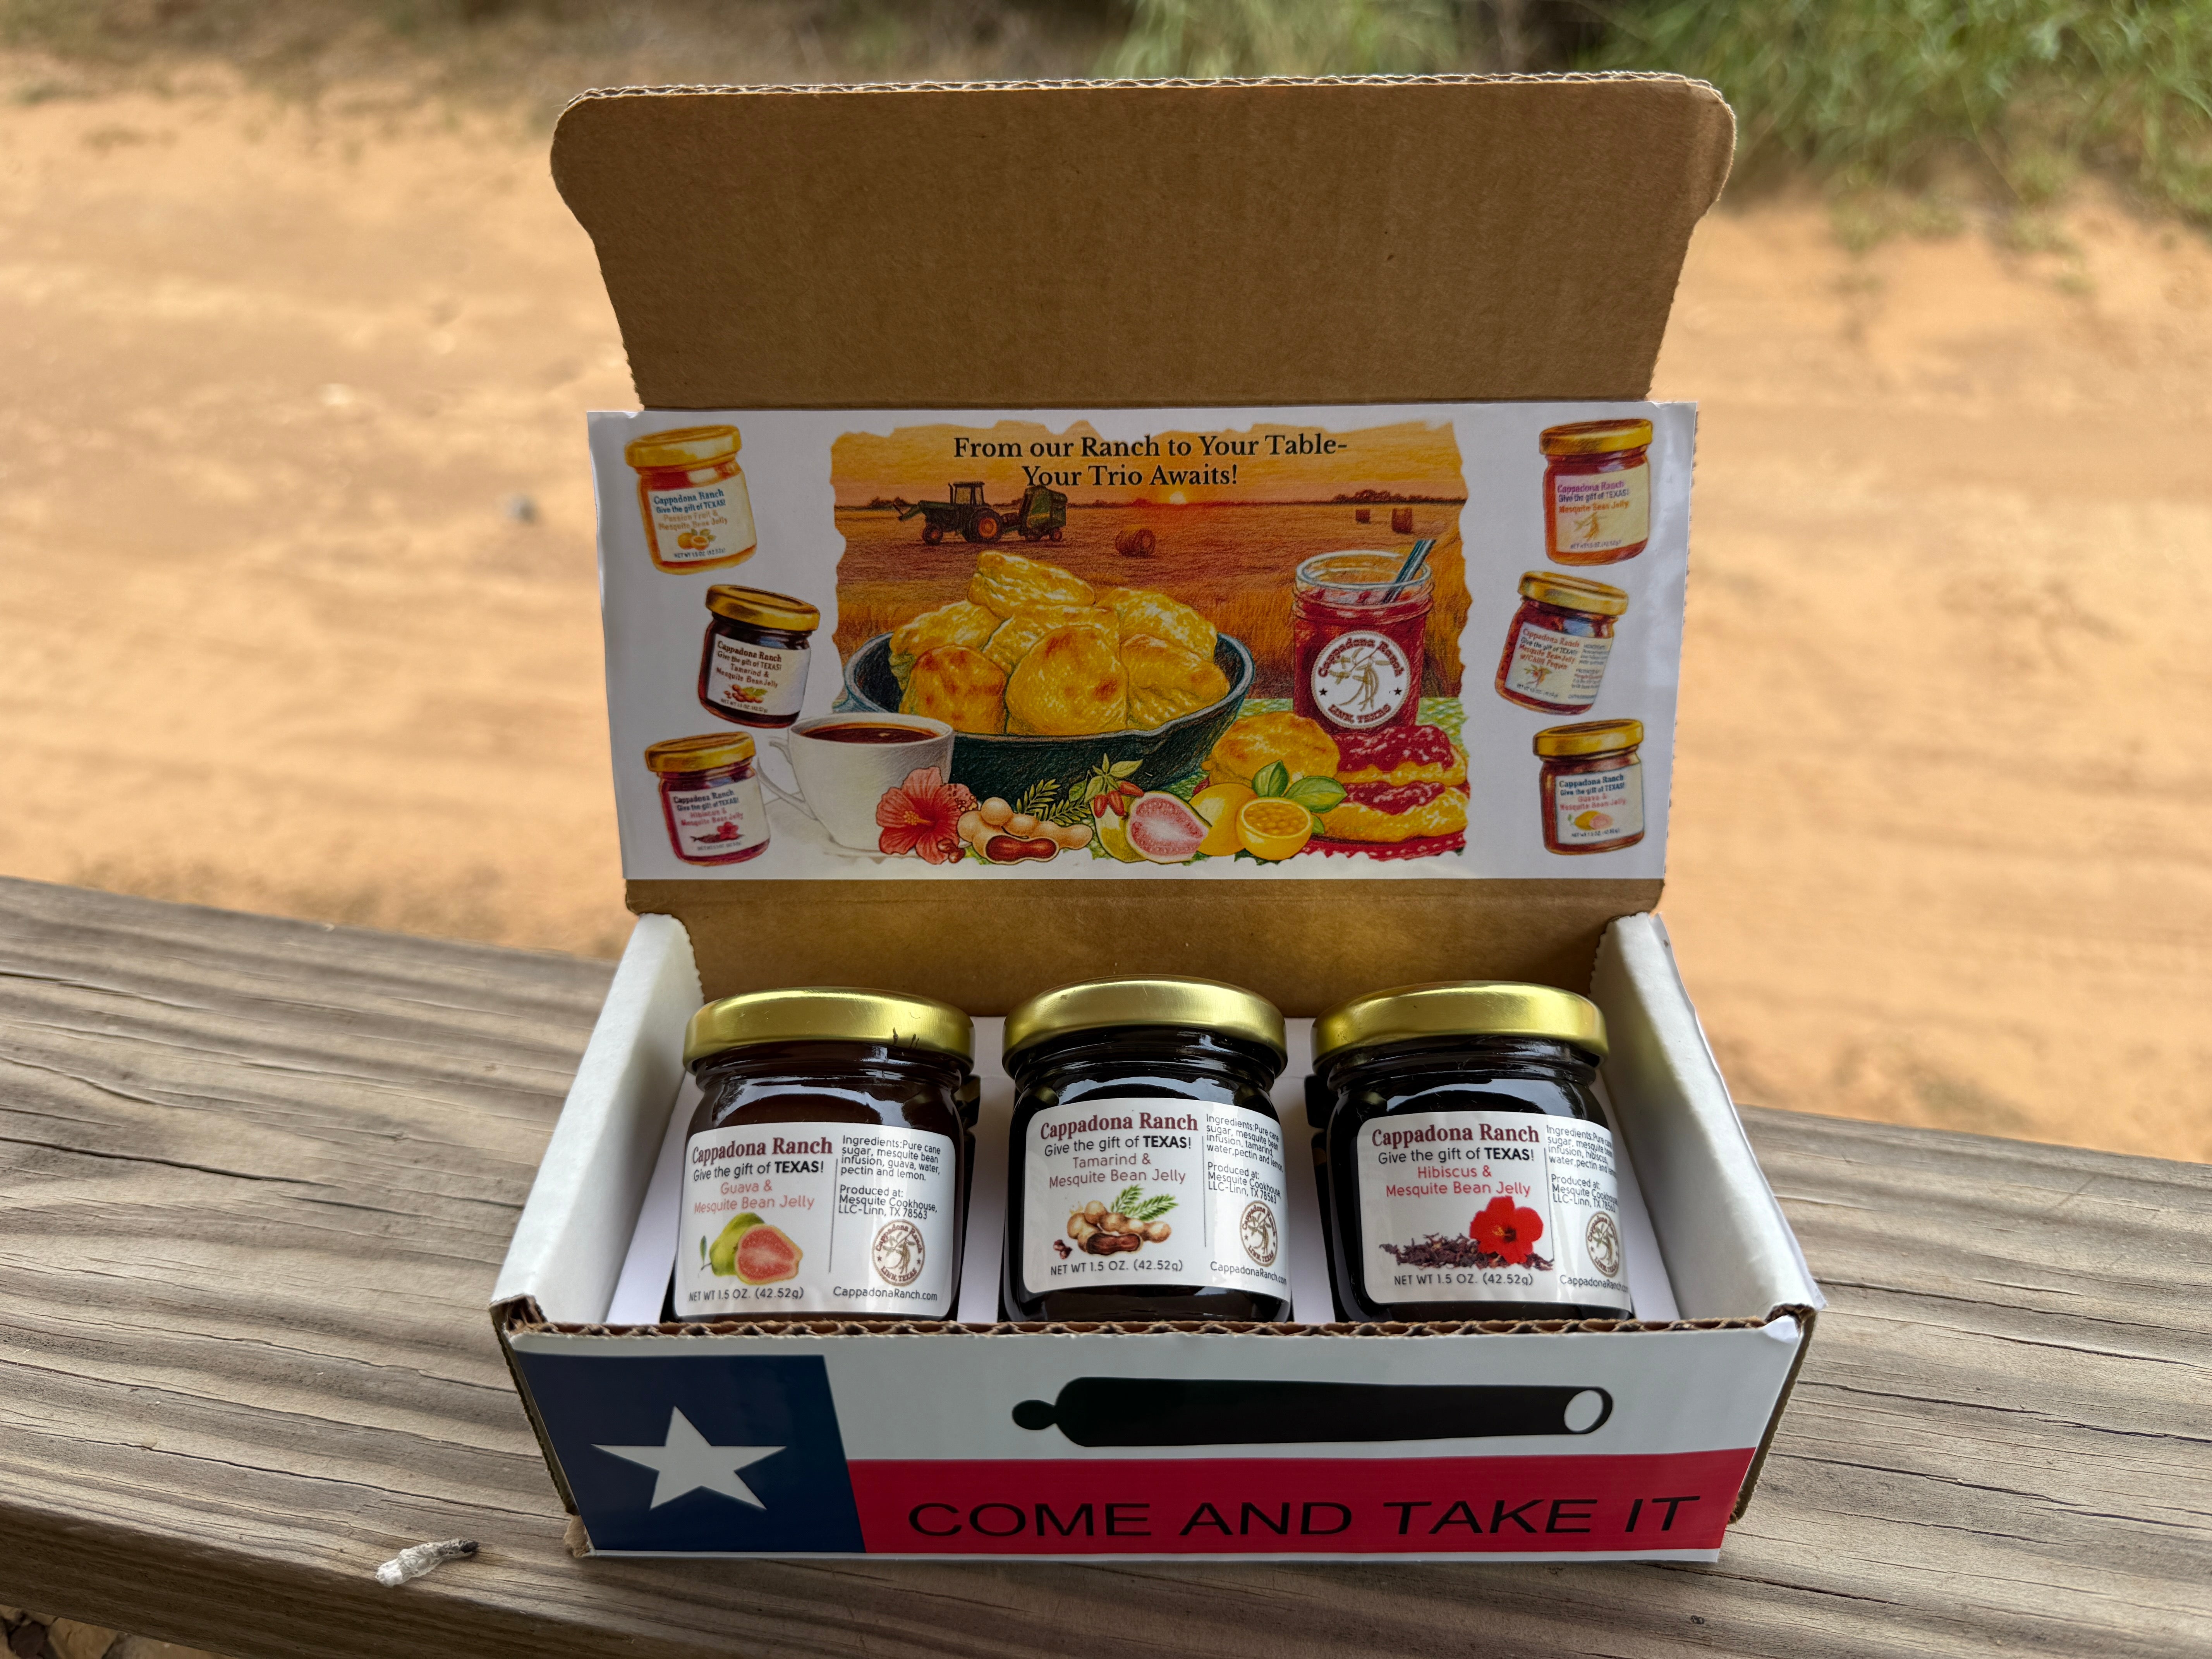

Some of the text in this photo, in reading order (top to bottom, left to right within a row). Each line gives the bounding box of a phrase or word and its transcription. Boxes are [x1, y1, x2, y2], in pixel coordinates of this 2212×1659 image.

[954, 434, 1347, 458] From our Ranch to Your Table-
[1022, 465, 1238, 487] Your Trio Awaits!
[1041, 1112, 1198, 1141] Cappadona Ranch
[1207, 1125, 1233, 1136] sugar,
[1237, 1130, 1266, 1144] mesquite
[1207, 1133, 1243, 1147] infusion,
[1372, 1123, 1540, 1149] Cappadona Ranch
[692, 1137, 833, 1166] Cappadona Ranch
[925, 1145, 941, 1154] cane
[1045, 1136, 1191, 1156] Give the gift of TEXAS!
[1547, 1137, 1574, 1147] sugar,
[1577, 1140, 1603, 1153] mesquite
[1548, 1144, 1583, 1158] infusion,
[842, 1147, 938, 1163] sugar, mesquite bean
[1073, 1153, 1151, 1168] Tamarind &
[1259, 1155, 1269, 1164] and
[1379, 1147, 1534, 1164] Give the gift of TEXAS!
[694, 1161, 824, 1182] Give the gift of TEXAS!
[841, 1166, 926, 1180] pectin and lemon.
[842, 1155, 940, 1175] infusion, guava, water,
[1208, 1162, 1249, 1176] Produced
[1418, 1165, 1492, 1179] Hibiscus &
[1599, 1165, 1607, 1174] and
[1049, 1169, 1185, 1188] Mesquite Bean Jelly
[1208, 1172, 1247, 1185] Mesquite
[1551, 1174, 1591, 1187] Produced
[721, 1180, 772, 1194] Guava &
[840, 1185, 903, 1197] Produced at:
[1209, 1182, 1276, 1204] LLC-Linn, TX 78563
[1386, 1181, 1530, 1197] Mesquite Bean Jelly
[1552, 1183, 1589, 1196] Mesquite
[694, 1195, 815, 1214] Mesquite Bean Jelly
[840, 1194, 937, 1213] Mesquite Cookhouse,
[1553, 1193, 1591, 1207] LLC-Linn,
[1593, 1199, 1601, 1208] TX
[838, 1204, 927, 1219] LLC-Linn, TX 78563
[1051, 1259, 1183, 1275] NET WT 1.5 OZ. (42.52g)
[1211, 1261, 1286, 1285] CappadonaRanch.com
[1394, 1273, 1533, 1285] NET WT 1.5 OZ. (42.52g)
[689, 1286, 804, 1301] NET WT 1.5 OZ. (42.52g)
[833, 1286, 937, 1300] CappadonaRanch.com
[908, 1495, 1701, 1537] COME AND TAKE IT
